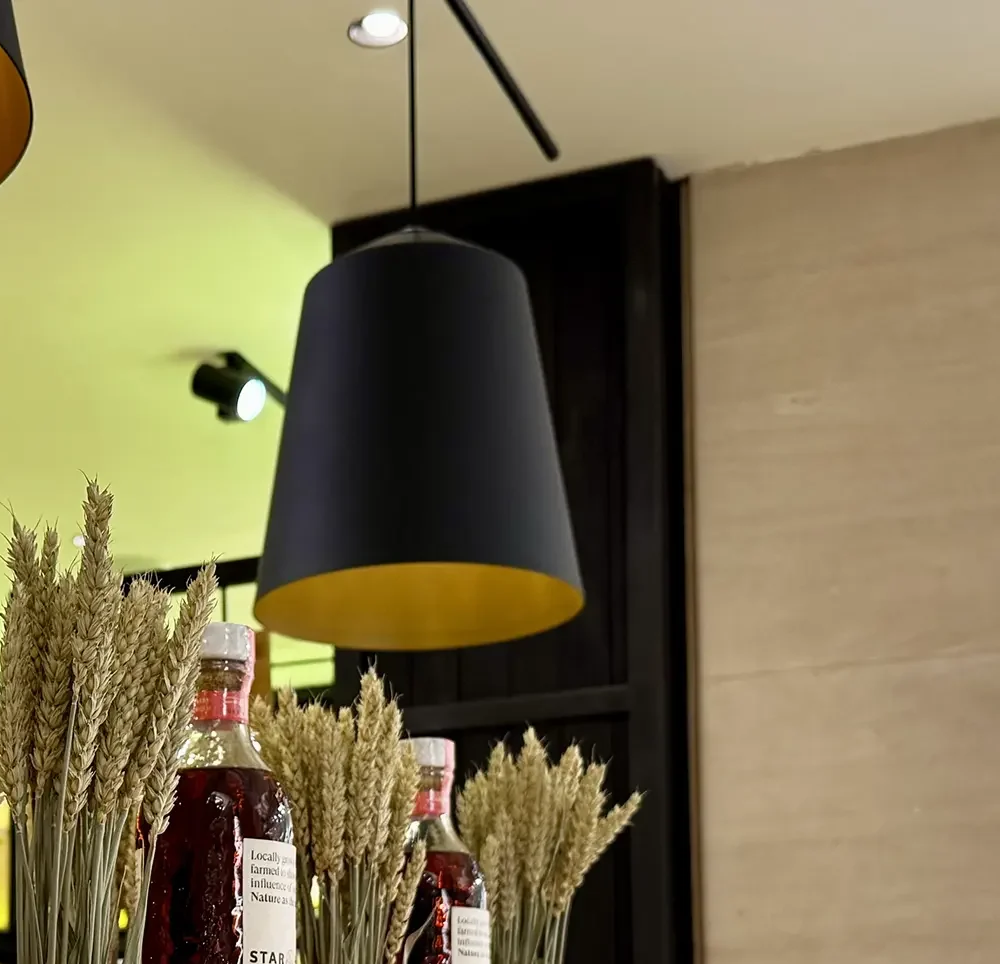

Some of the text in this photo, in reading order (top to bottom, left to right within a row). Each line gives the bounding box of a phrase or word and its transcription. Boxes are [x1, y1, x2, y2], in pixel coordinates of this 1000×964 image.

[251, 850, 280, 865] Locally
[251, 863, 280, 876] farmed
[251, 877, 287, 891] influence
[251, 891, 280, 904] Nature
[249, 950, 284, 964] STAR
